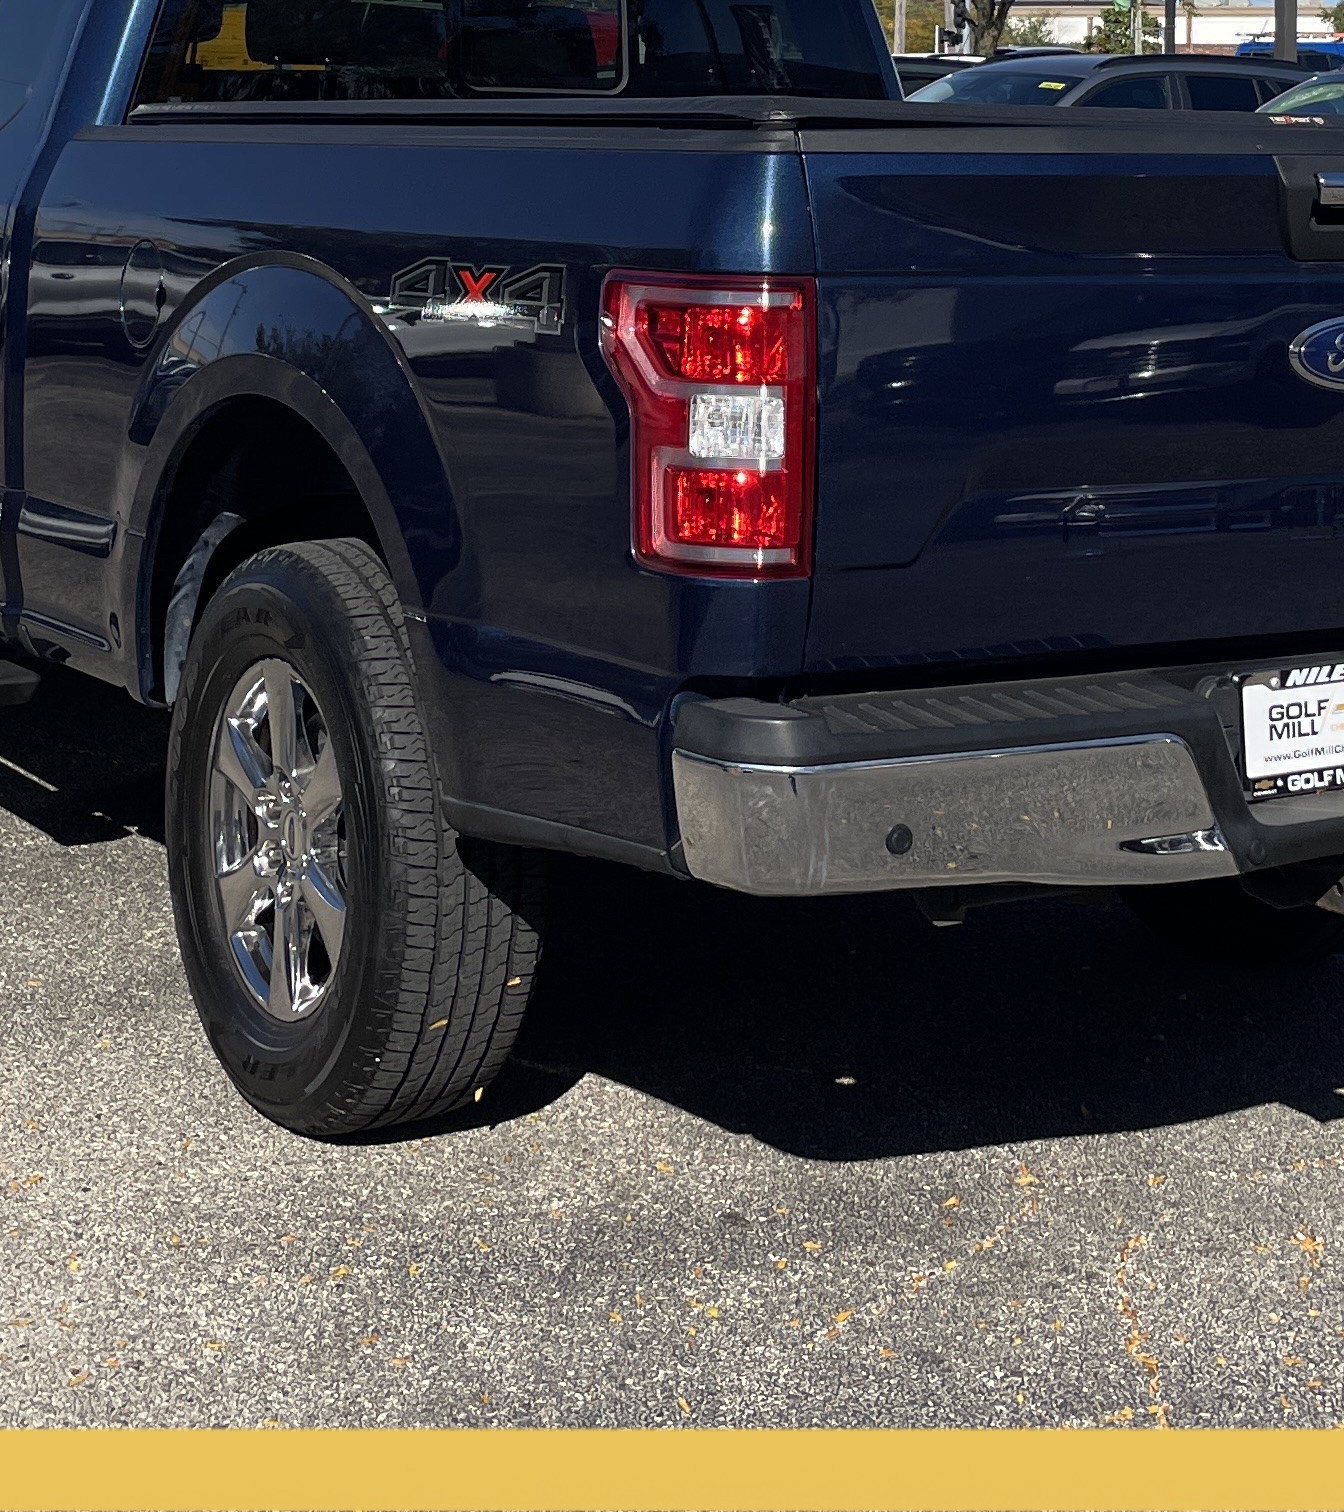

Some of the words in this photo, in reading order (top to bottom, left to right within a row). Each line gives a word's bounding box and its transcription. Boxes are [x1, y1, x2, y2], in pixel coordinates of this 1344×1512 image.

[1268, 698, 1330, 722] GOLF
[1269, 719, 1319, 741] MILL
[1287, 769, 1334, 792] GOLF
